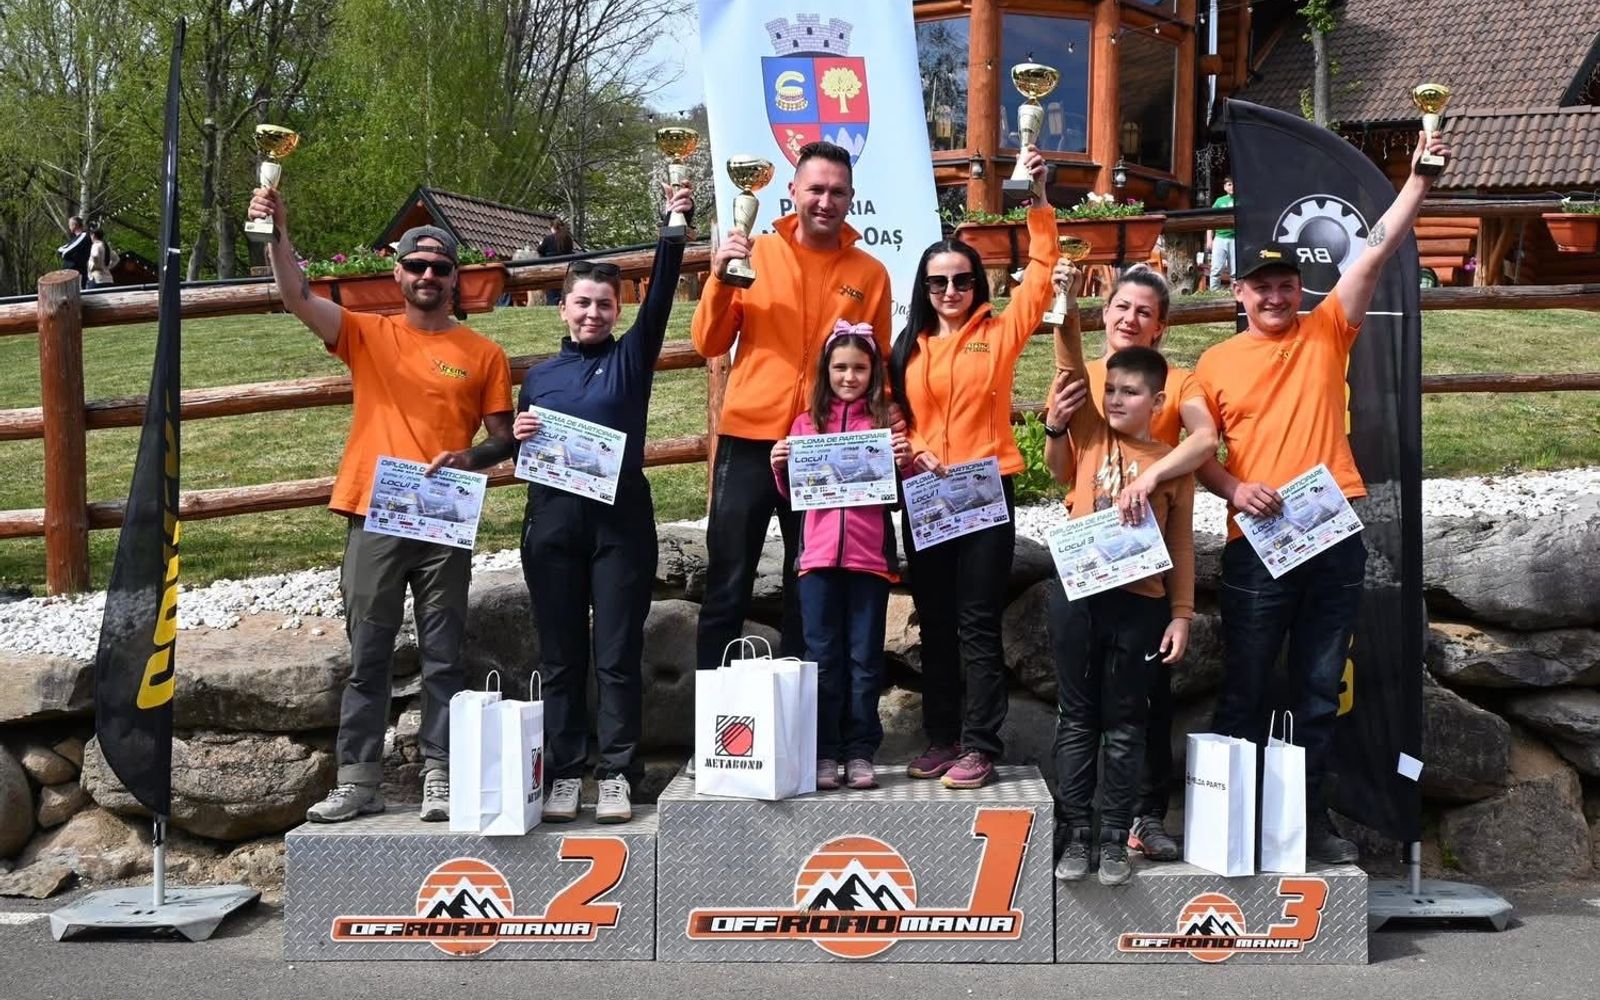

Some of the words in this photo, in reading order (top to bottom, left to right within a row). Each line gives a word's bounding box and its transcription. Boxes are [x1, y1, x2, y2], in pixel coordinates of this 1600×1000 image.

[791, 437, 826, 446] DIPLOMA
[839, 432, 887, 442] PARTICIPARE
[380, 459, 418, 472] DIPLOMA
[436, 469, 482, 484] ARTICIPARE
[1088, 536, 1095, 544] 3
[704, 758, 763, 770] METABOND
[1206, 780, 1226, 791] PARTS
[970, 807, 1035, 913] 1
[546, 837, 628, 926] 2
[1268, 878, 1328, 941] 3
